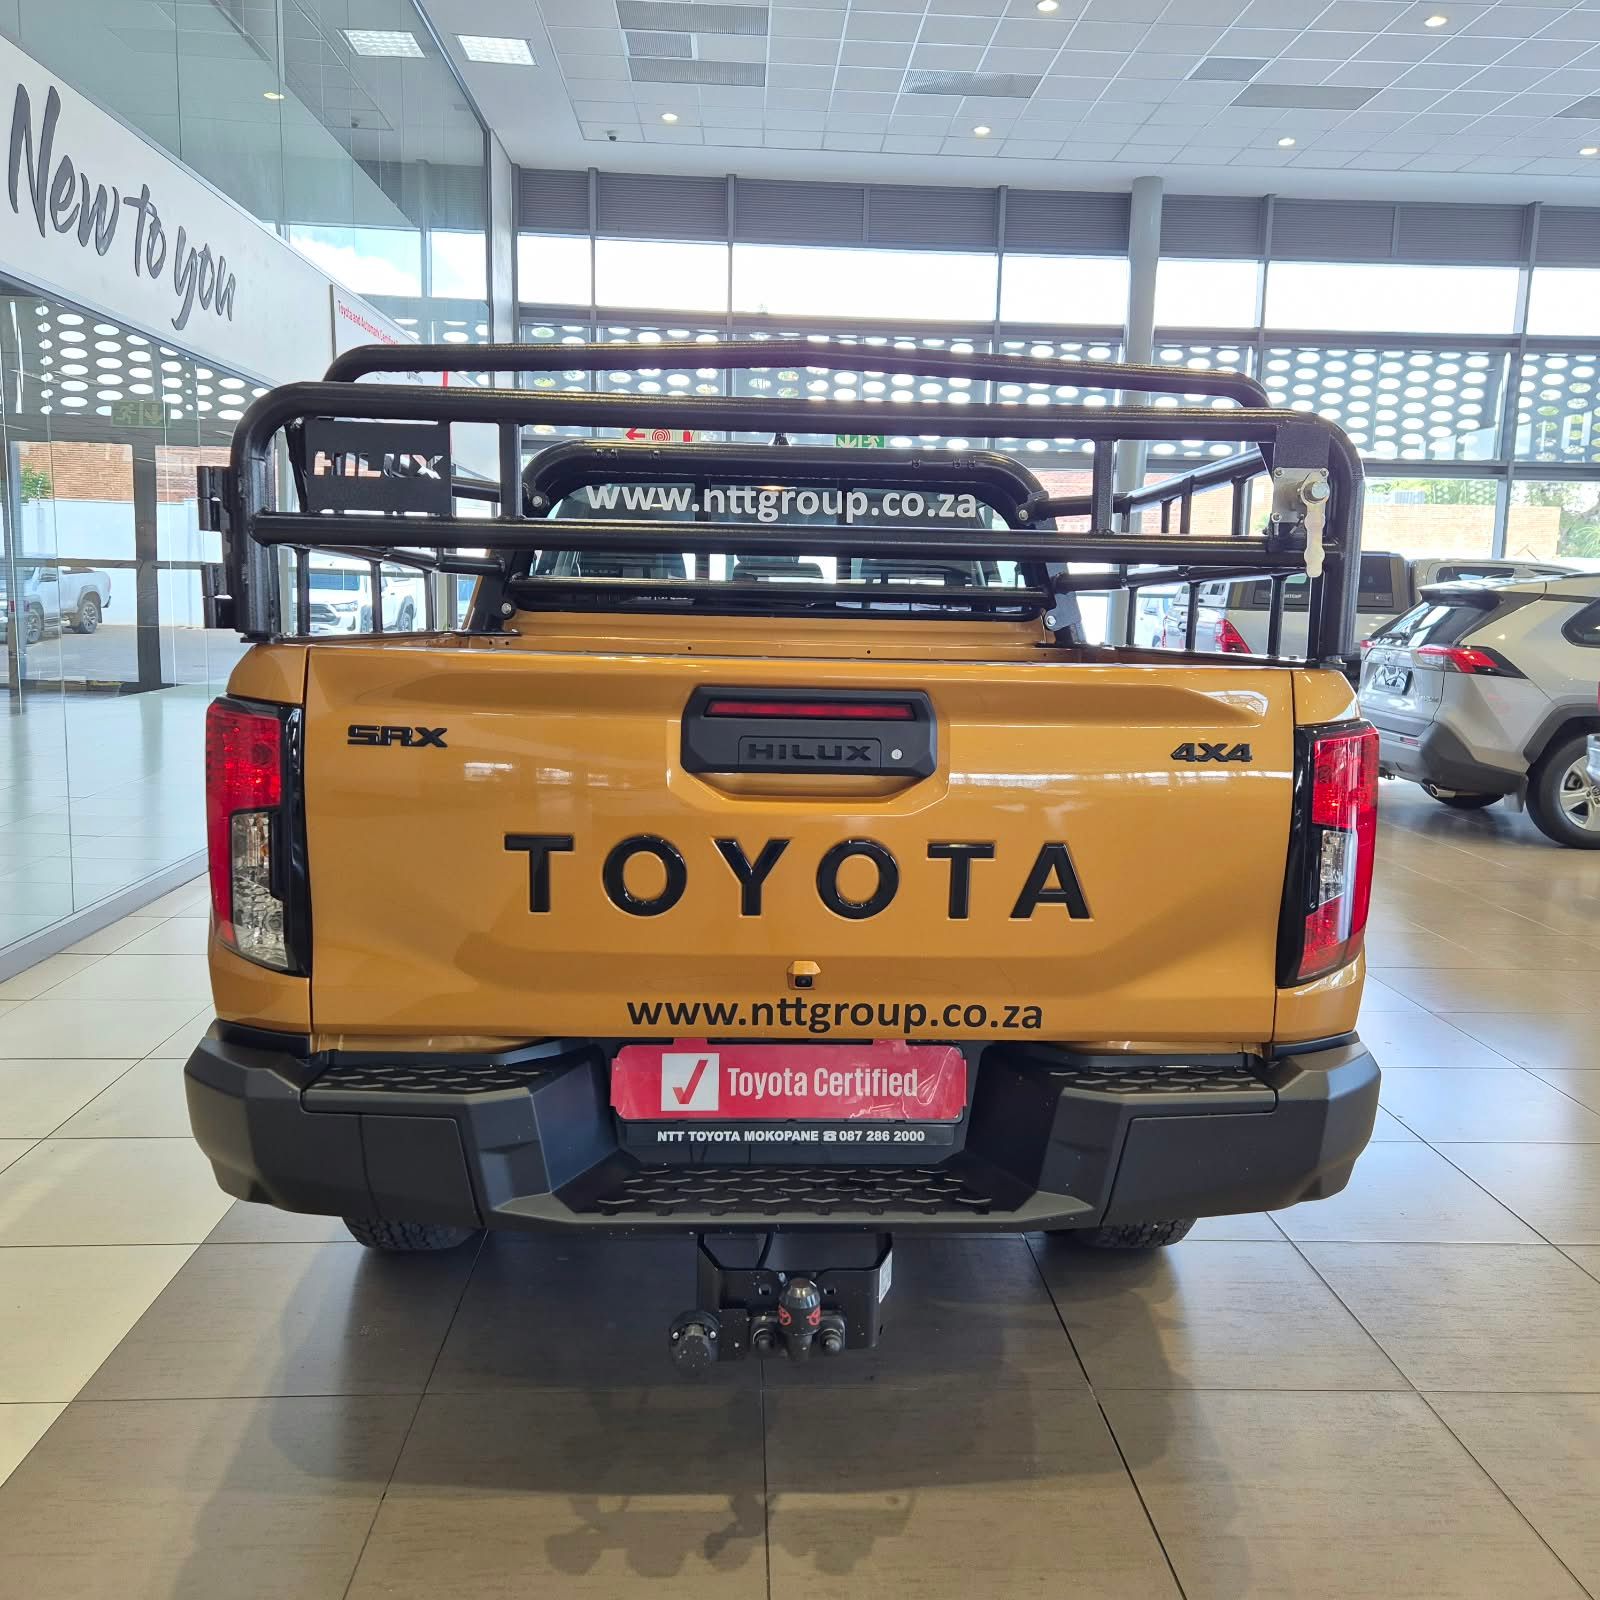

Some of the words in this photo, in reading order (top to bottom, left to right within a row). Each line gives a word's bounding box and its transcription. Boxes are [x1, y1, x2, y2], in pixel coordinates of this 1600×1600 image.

[8, 83, 120, 256] New
[123, 183, 166, 279] to
[171, 226, 236, 331] you
[313, 451, 444, 480] HILUX
[586, 482, 978, 523] www.nttgroup.co.za
[347, 724, 448, 747] SRX
[747, 742, 873, 762] HILUX
[504, 833, 1094, 921] TOYOTA
[626, 997, 1044, 1033] www.nttgroup.co.za
[727, 1067, 808, 1100] Toyota
[813, 1067, 918, 1097] Certified
[657, 1130, 685, 1143] NTT
[687, 1130, 741, 1143] TOYOTA
[743, 1130, 819, 1142] MOKOPANE
[838, 1130, 862, 1142] 087
[865, 1130, 890, 1142] 286
[893, 1130, 925, 1142] 2000
